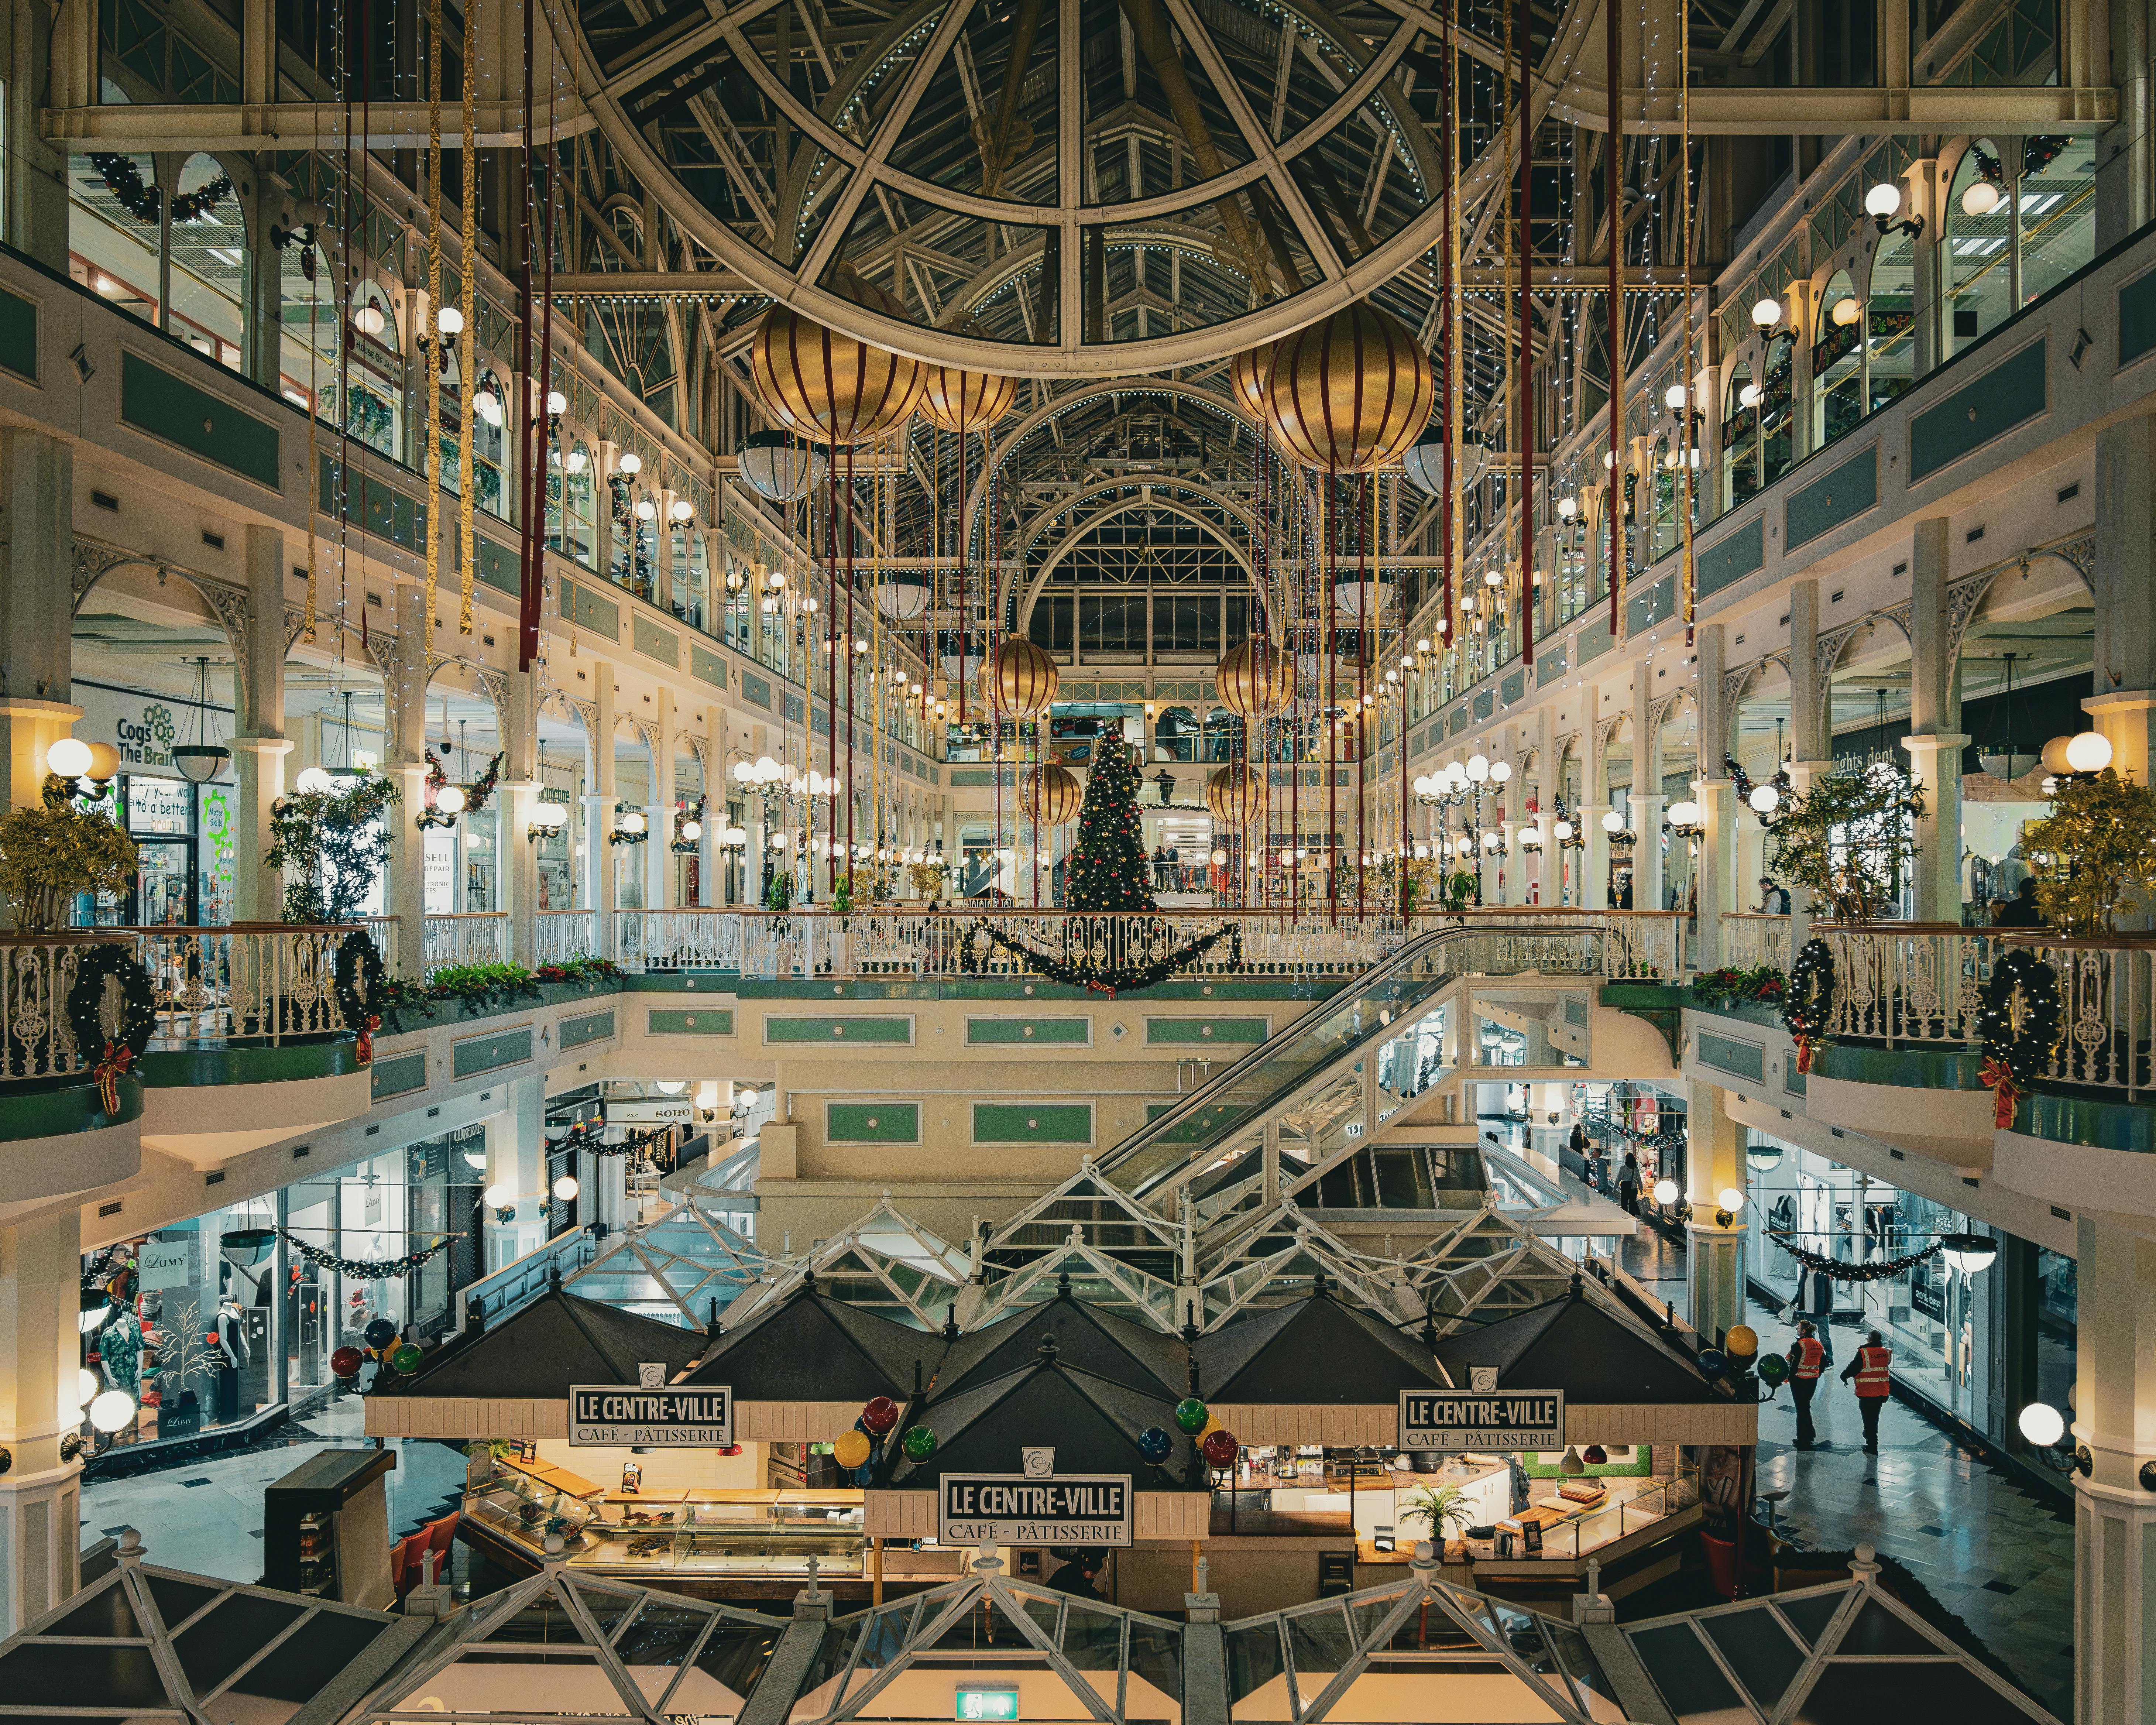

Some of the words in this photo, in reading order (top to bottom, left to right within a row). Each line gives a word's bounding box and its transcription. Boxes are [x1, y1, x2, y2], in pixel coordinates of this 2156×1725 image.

[356, 339, 374, 359] HOUSE
[375, 353, 383, 364] OF
[384, 359, 400, 377] JAPAN
[117, 718, 151, 747] Cogs
[117, 742, 142, 764] The
[1833, 751, 1862, 777] ights
[130, 778, 149, 799] Play
[151, 803, 156, 814] a
[161, 800, 189, 816] better
[151, 816, 174, 831] brain
[210, 818, 223, 827] Skills
[425, 853, 450, 862] SELL
[655, 1109, 690, 1118] SOHO
[1916, 1290, 1928, 1302] 20%
[1929, 1297, 1940, 1307] OFF
[1918, 1371, 1928, 1382] JACK
[1927, 1379, 1939, 1390] WILLS
[580, 1397, 598, 1419] LE
[603, 1397, 722, 1420] CENTRE-VILLE
[1410, 1401, 1429, 1424] LE
[1434, 1401, 1554, 1424] CENTRE-VILLE
[577, 1426, 618, 1441] CAFÉ
[634, 1426, 723, 1443] PÂTISSERIE
[1407, 1431, 1448, 1446] CAFÉ
[1465, 1430, 1555, 1447] PÂTISSERIE
[952, 1487, 974, 1513] LE
[979, 1487, 1120, 1515] CENTRE-VILLE
[949, 1522, 997, 1539] CAFÉ
[1016, 1522, 1122, 1541] PÂTISSERIE
